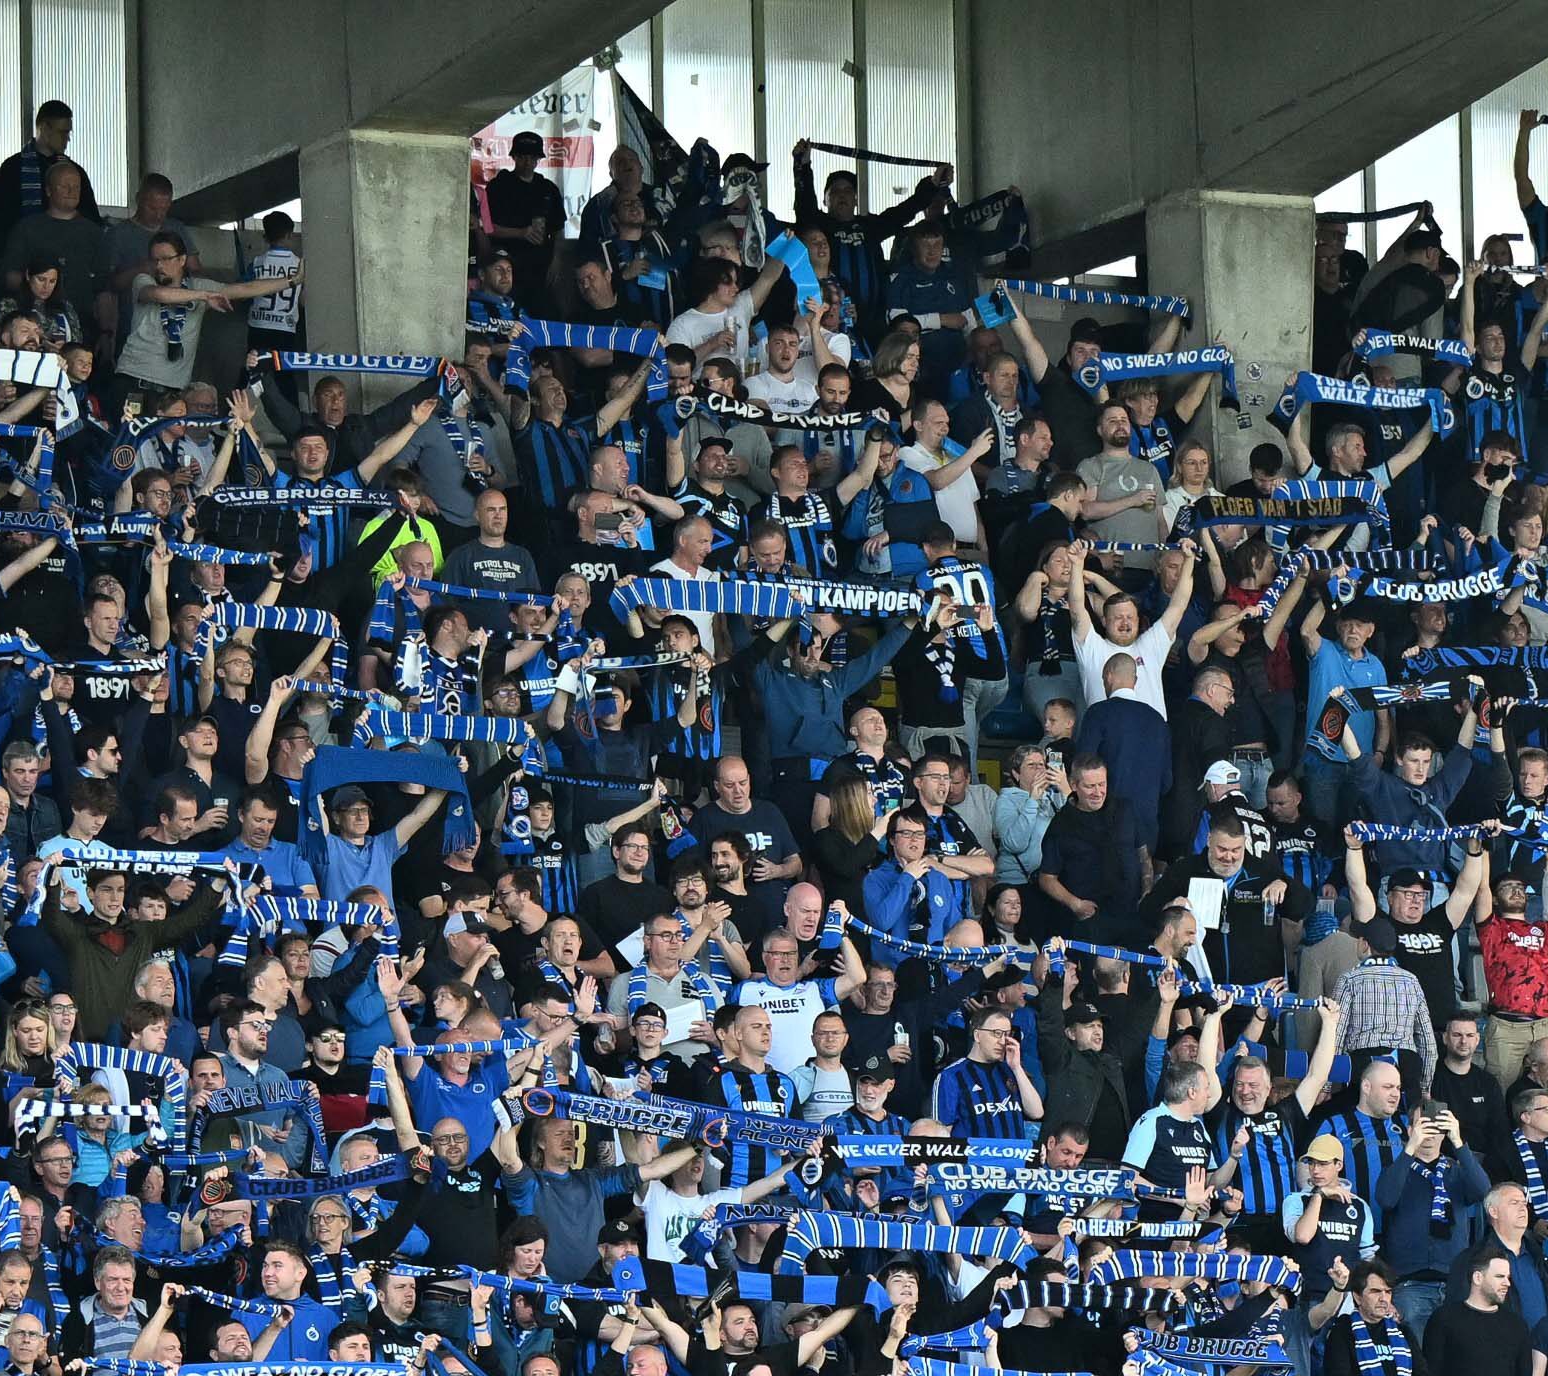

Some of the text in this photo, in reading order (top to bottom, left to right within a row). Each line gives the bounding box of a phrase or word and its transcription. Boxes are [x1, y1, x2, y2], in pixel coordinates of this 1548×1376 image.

[1102, 351, 1173, 372] NO SWEAT
[214, 487, 364, 503] CLUB BRUGGE
[927, 562, 982, 578] CANDRIAM
[862, 1143, 1039, 1162] NEVER WALK ALONE
[938, 1162, 1123, 1185] CLUB BRUGGE
[1062, 1180, 1118, 1197] GLORY
